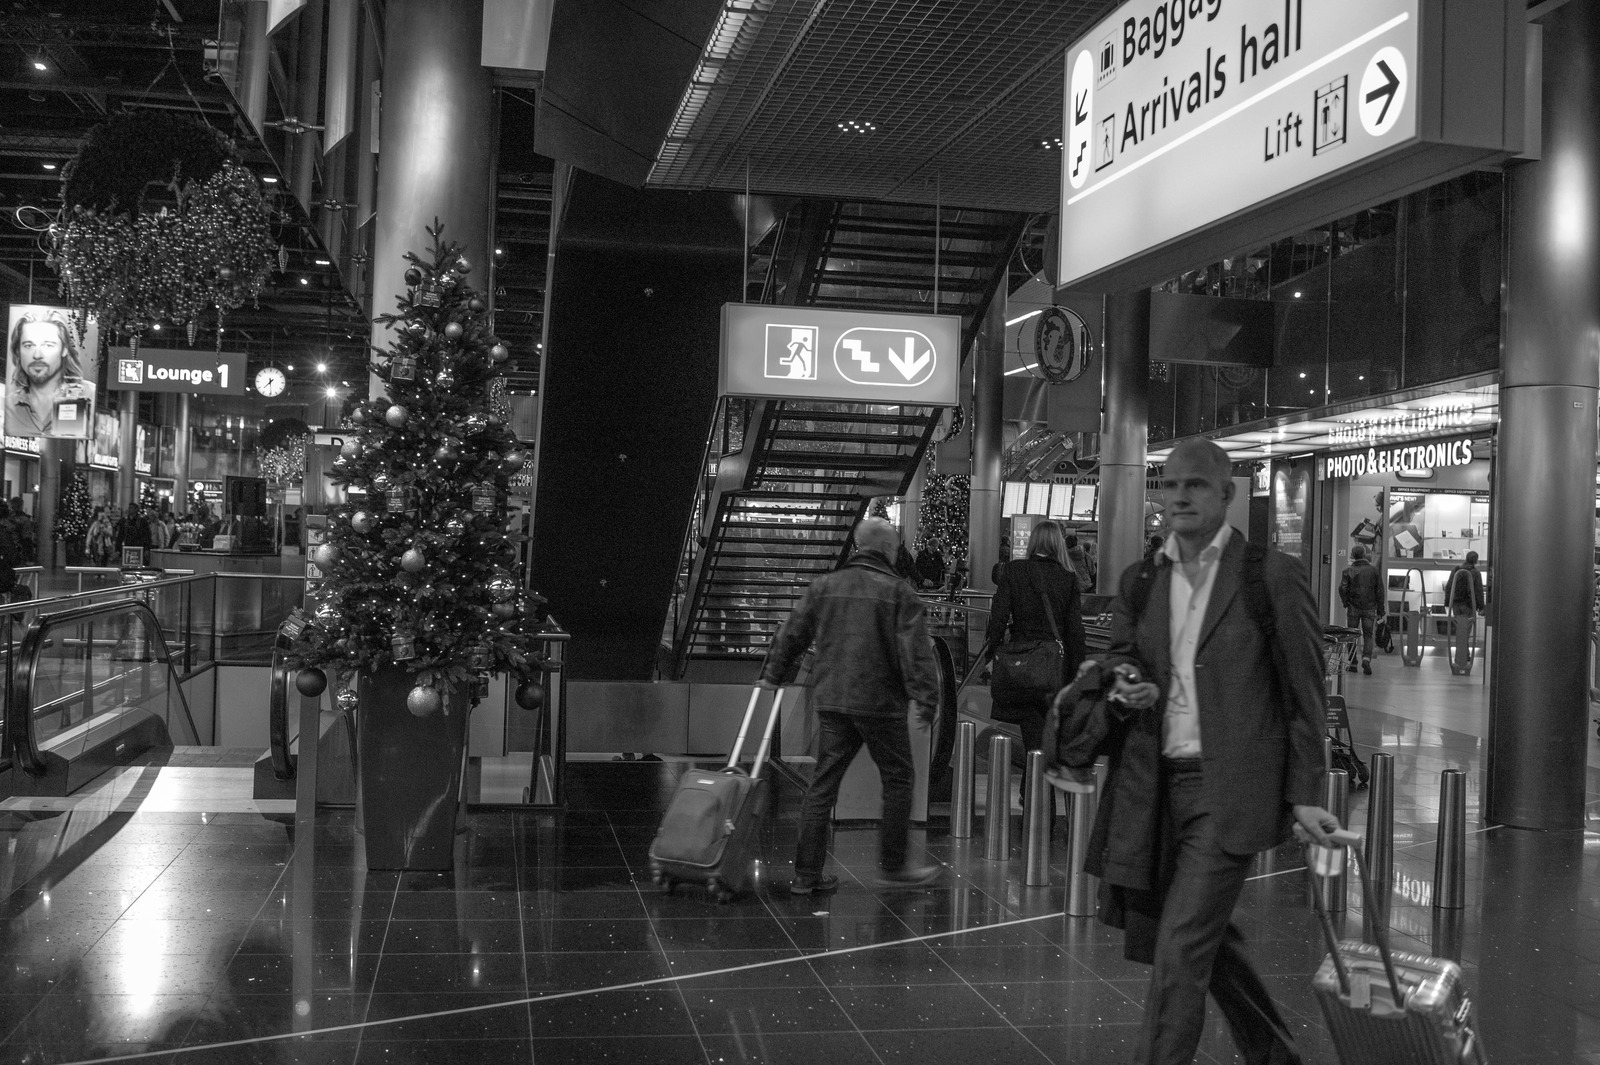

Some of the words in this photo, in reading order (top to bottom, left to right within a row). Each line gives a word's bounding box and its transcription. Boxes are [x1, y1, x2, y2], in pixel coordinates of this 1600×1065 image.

[1121, 47, 1227, 153] Arrivals
[1240, 0, 1301, 84] hall
[1264, 112, 1303, 162] Lift
[148, 364, 213, 385] Lounge
[217, 364, 229, 388] 1
[1327, 454, 1366, 478] PHOTO
[1366, 448, 1378, 475] &
[1378, 439, 1472, 473] ELECTRONICS
